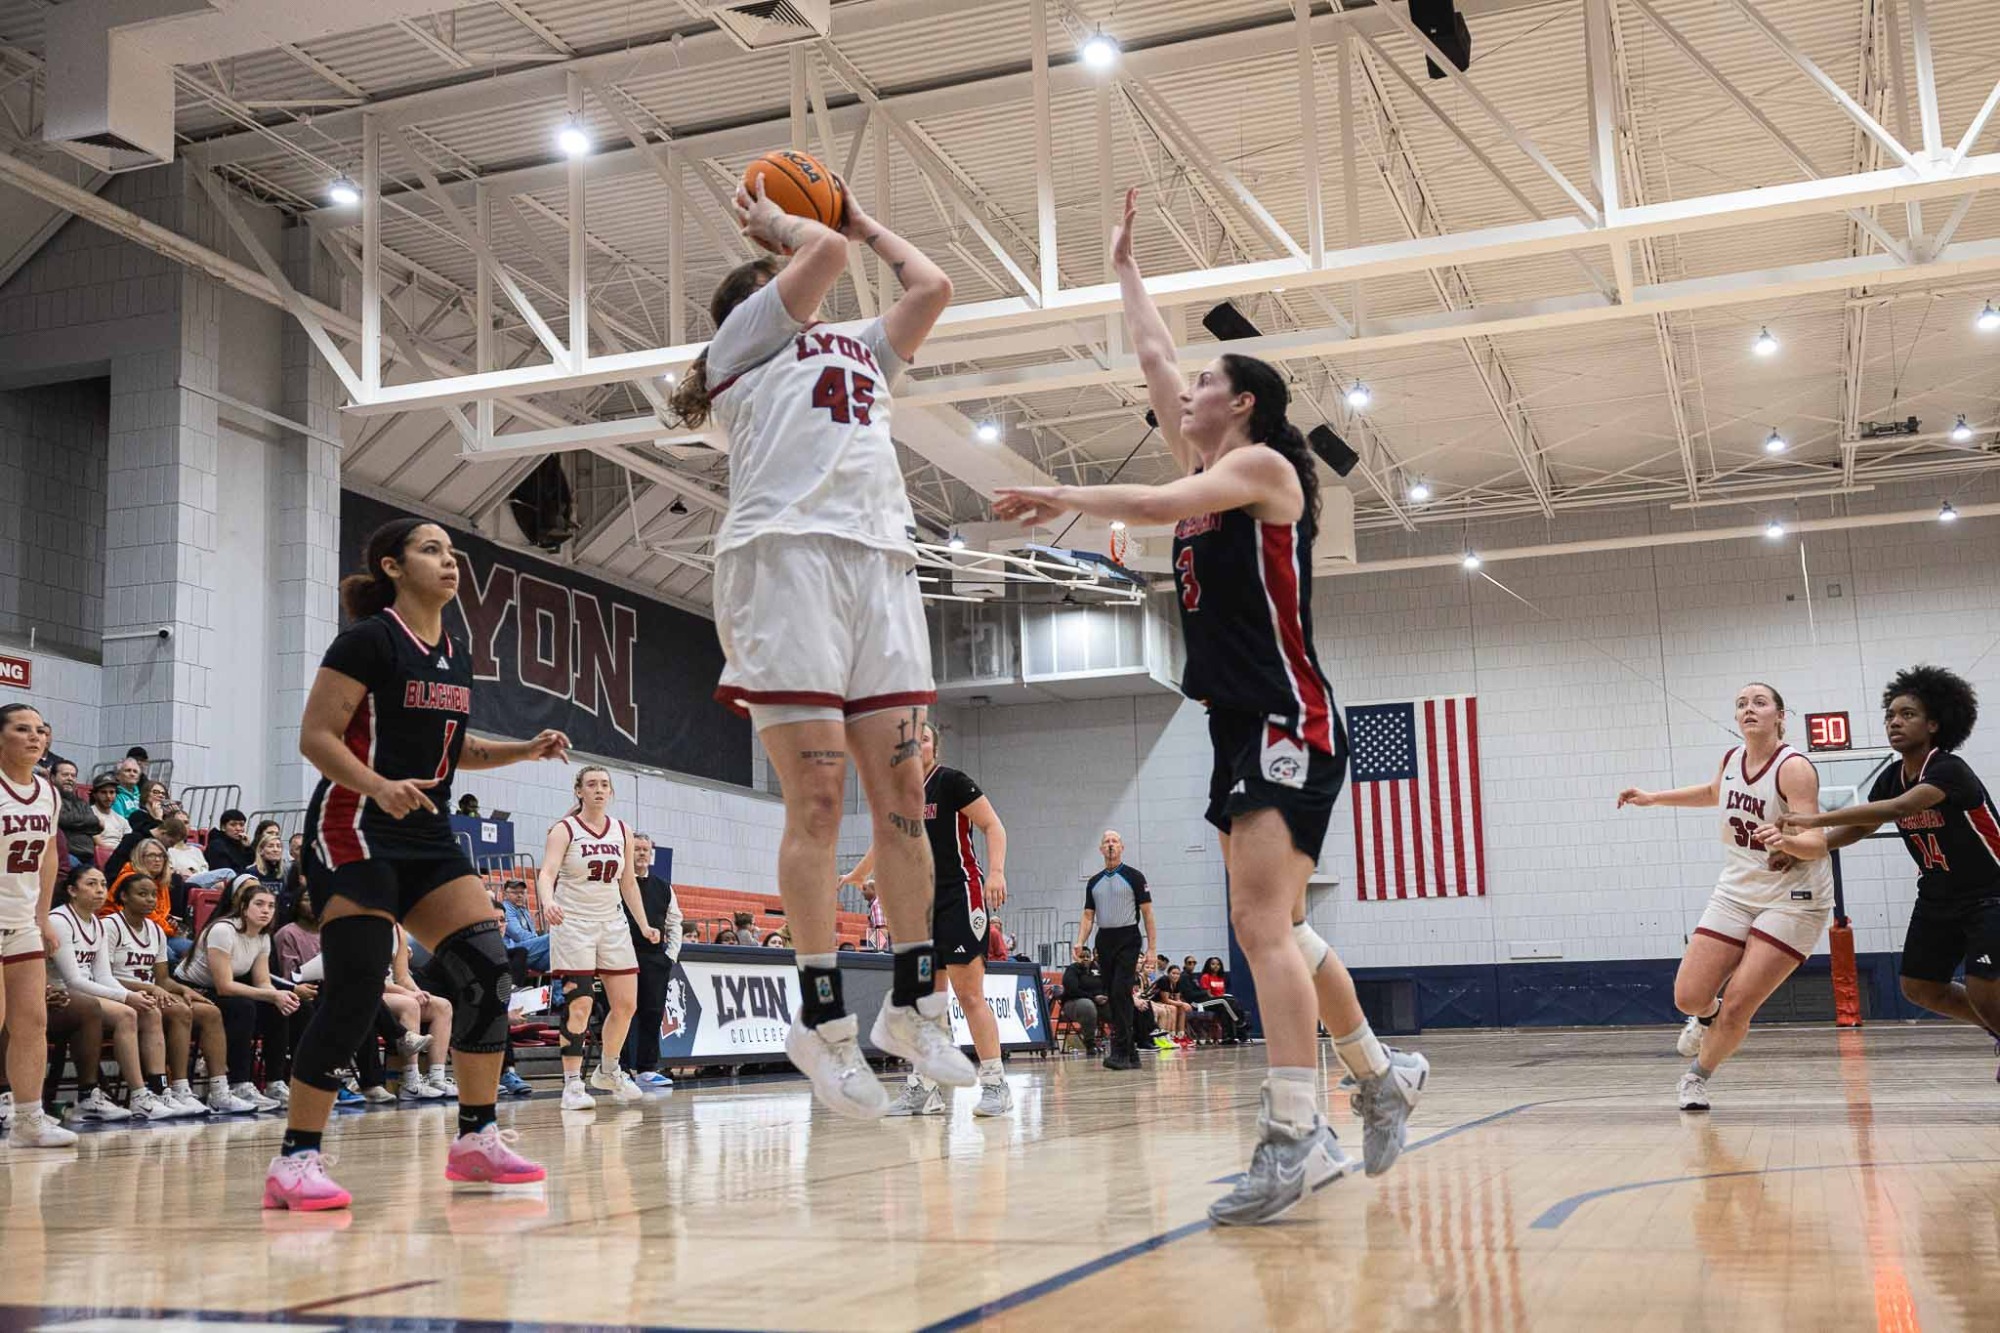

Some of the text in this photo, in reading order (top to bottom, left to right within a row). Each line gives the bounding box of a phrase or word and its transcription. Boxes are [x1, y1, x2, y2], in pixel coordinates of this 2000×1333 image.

[812, 366, 877, 426] 45
[450, 549, 639, 745] YON
[403, 680, 470, 714] BLACKBU
[1811, 717, 1847, 744] 30
[435, 720, 458, 780] 1
[1725, 790, 1767, 821] LYON
[2, 815, 51, 837] LYON
[7, 840, 45, 874] 23
[581, 843, 622, 858] LYON
[1909, 833, 1950, 872] 14
[587, 860, 619, 884] 30
[710, 974, 792, 1029] LYON
[995, 997, 1011, 1020] GO!
[730, 1027, 786, 1043] COLLEGE
